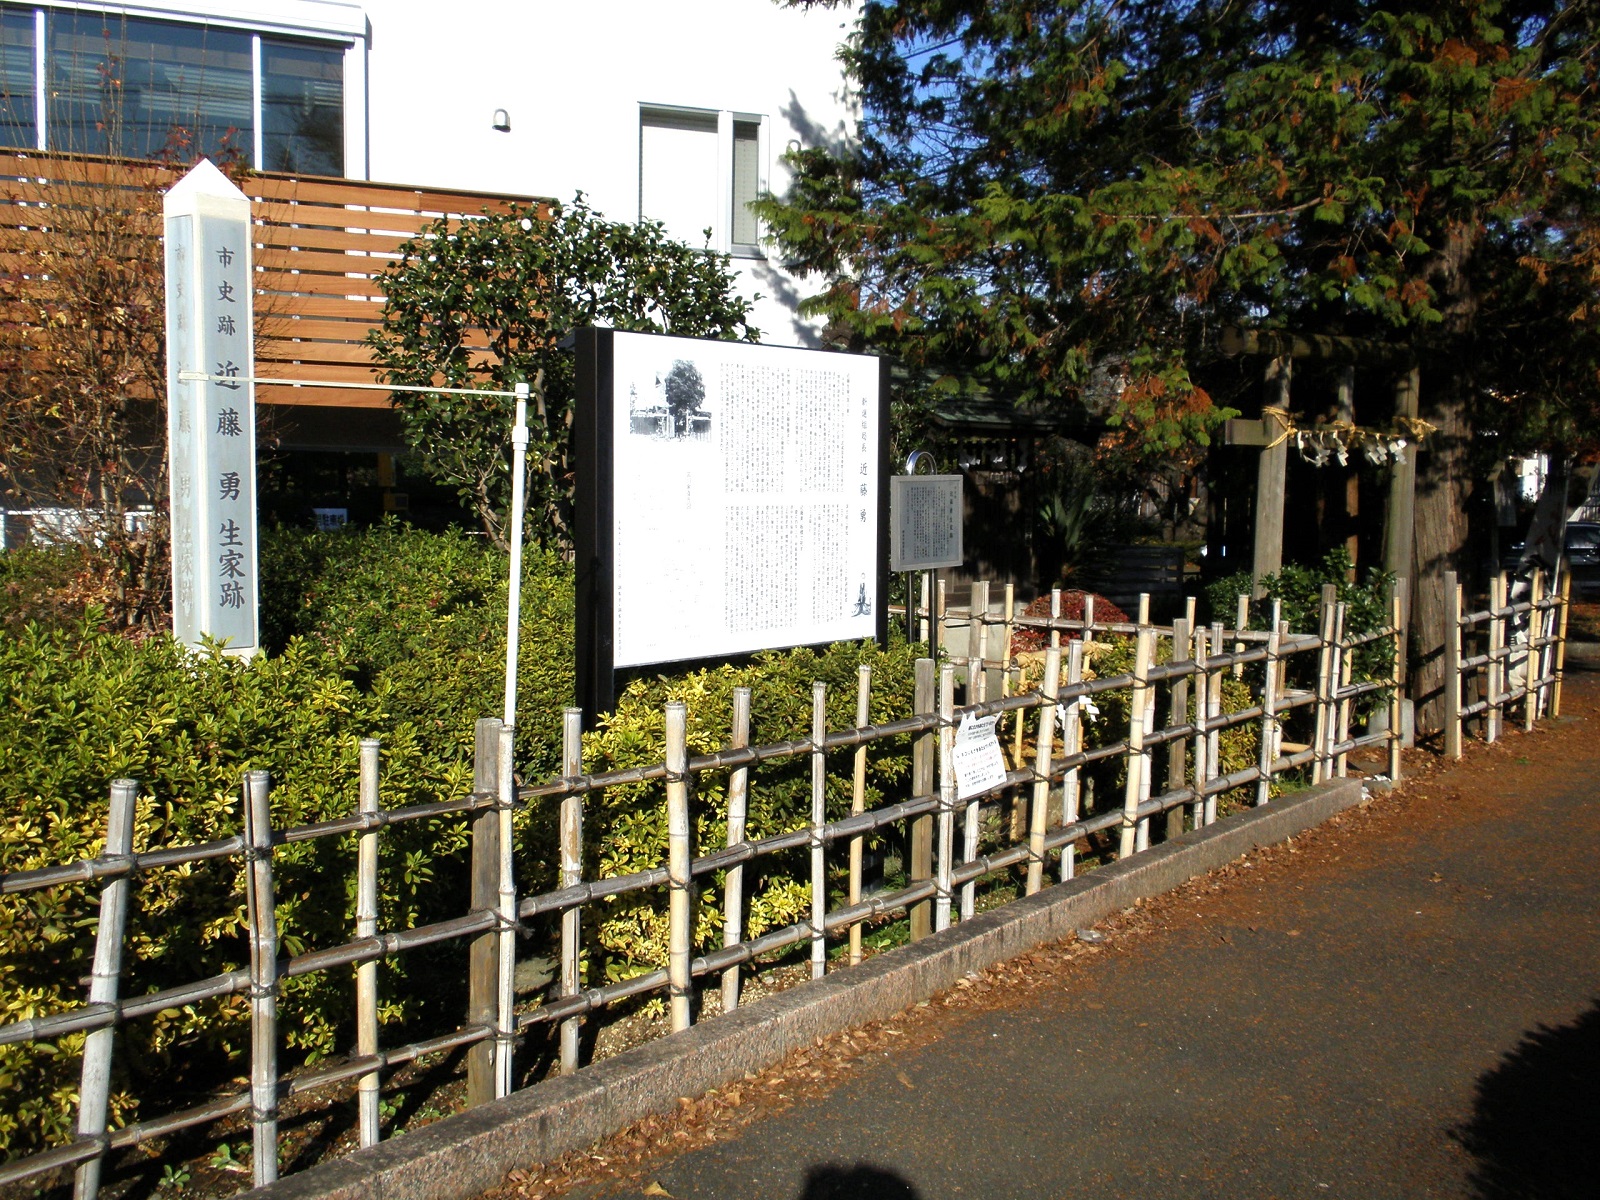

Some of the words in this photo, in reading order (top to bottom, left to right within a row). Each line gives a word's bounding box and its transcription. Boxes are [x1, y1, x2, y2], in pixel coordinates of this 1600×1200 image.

[215, 246, 246, 609] 市史跡近藤勇生家跡
